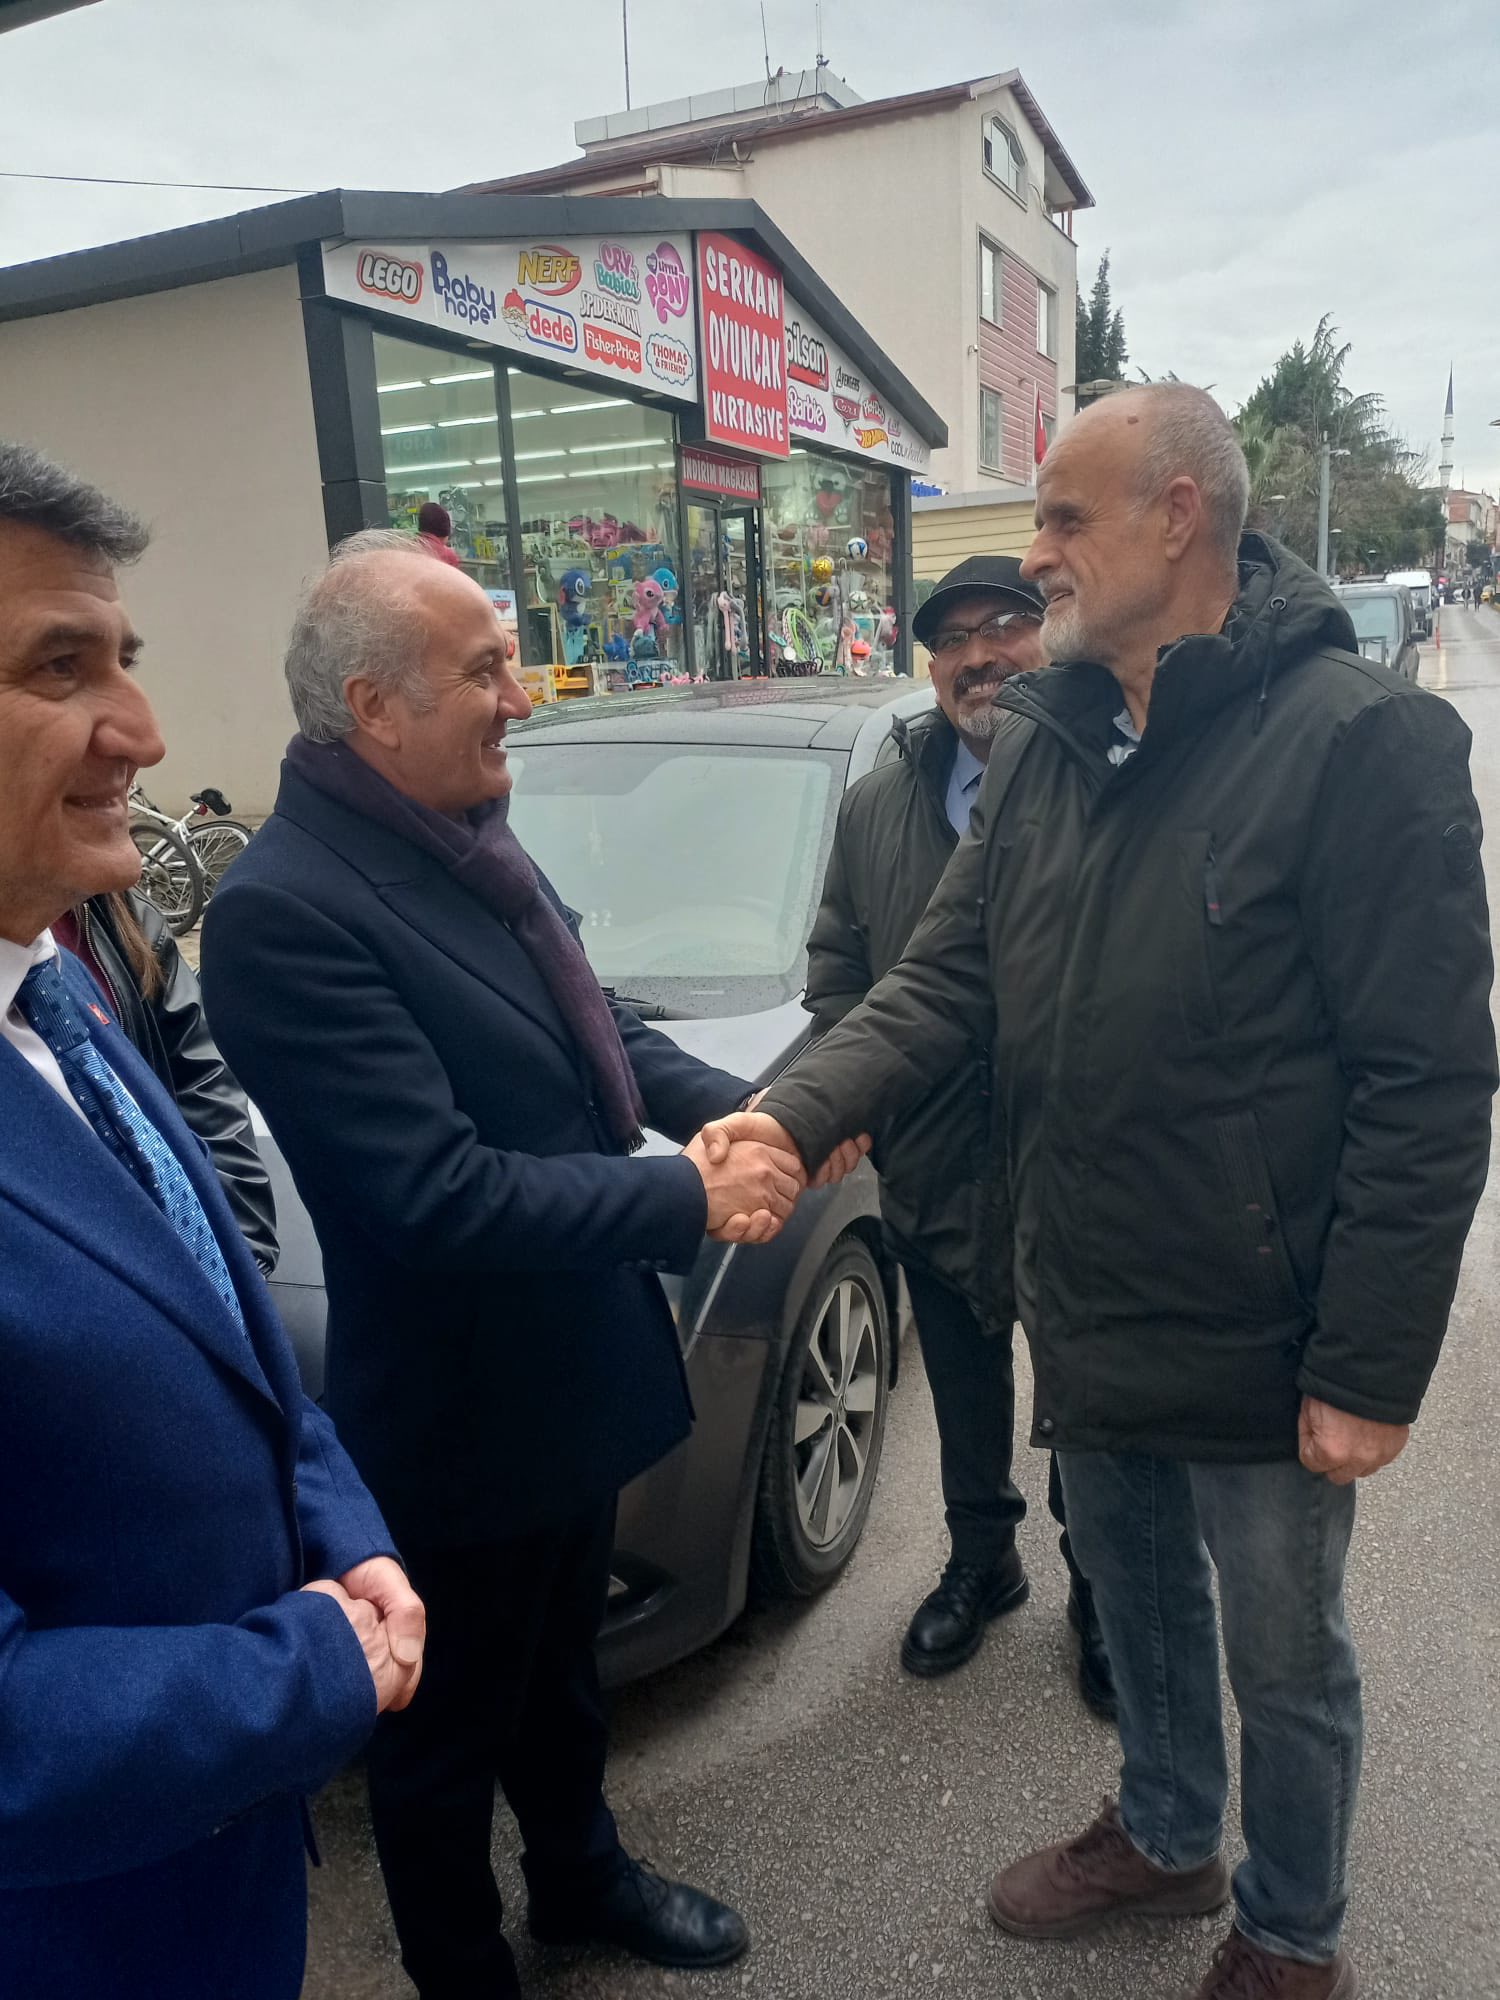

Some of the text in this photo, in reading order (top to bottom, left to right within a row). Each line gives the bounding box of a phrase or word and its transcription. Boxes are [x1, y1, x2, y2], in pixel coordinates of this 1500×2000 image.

[361, 254, 418, 299] LEGO
[518, 251, 579, 285] NERF
[601, 243, 632, 277] CRY
[431, 251, 496, 319] Baby
[596, 263, 638, 299] Babies
[645, 272, 689, 320] PONY
[706, 245, 779, 320] SERKAN
[444, 290, 490, 325] hope
[530, 308, 573, 345] dede
[580, 291, 641, 337] SPIDER-MAN
[586, 330, 640, 363] Fisher-Price
[652, 343, 688, 366] THOMAS
[709, 309, 781, 391] OYUNCAK
[785, 321, 825, 376] pilsan
[655, 359, 686, 377] & FRIENDS
[788, 386, 825, 427] Barbie
